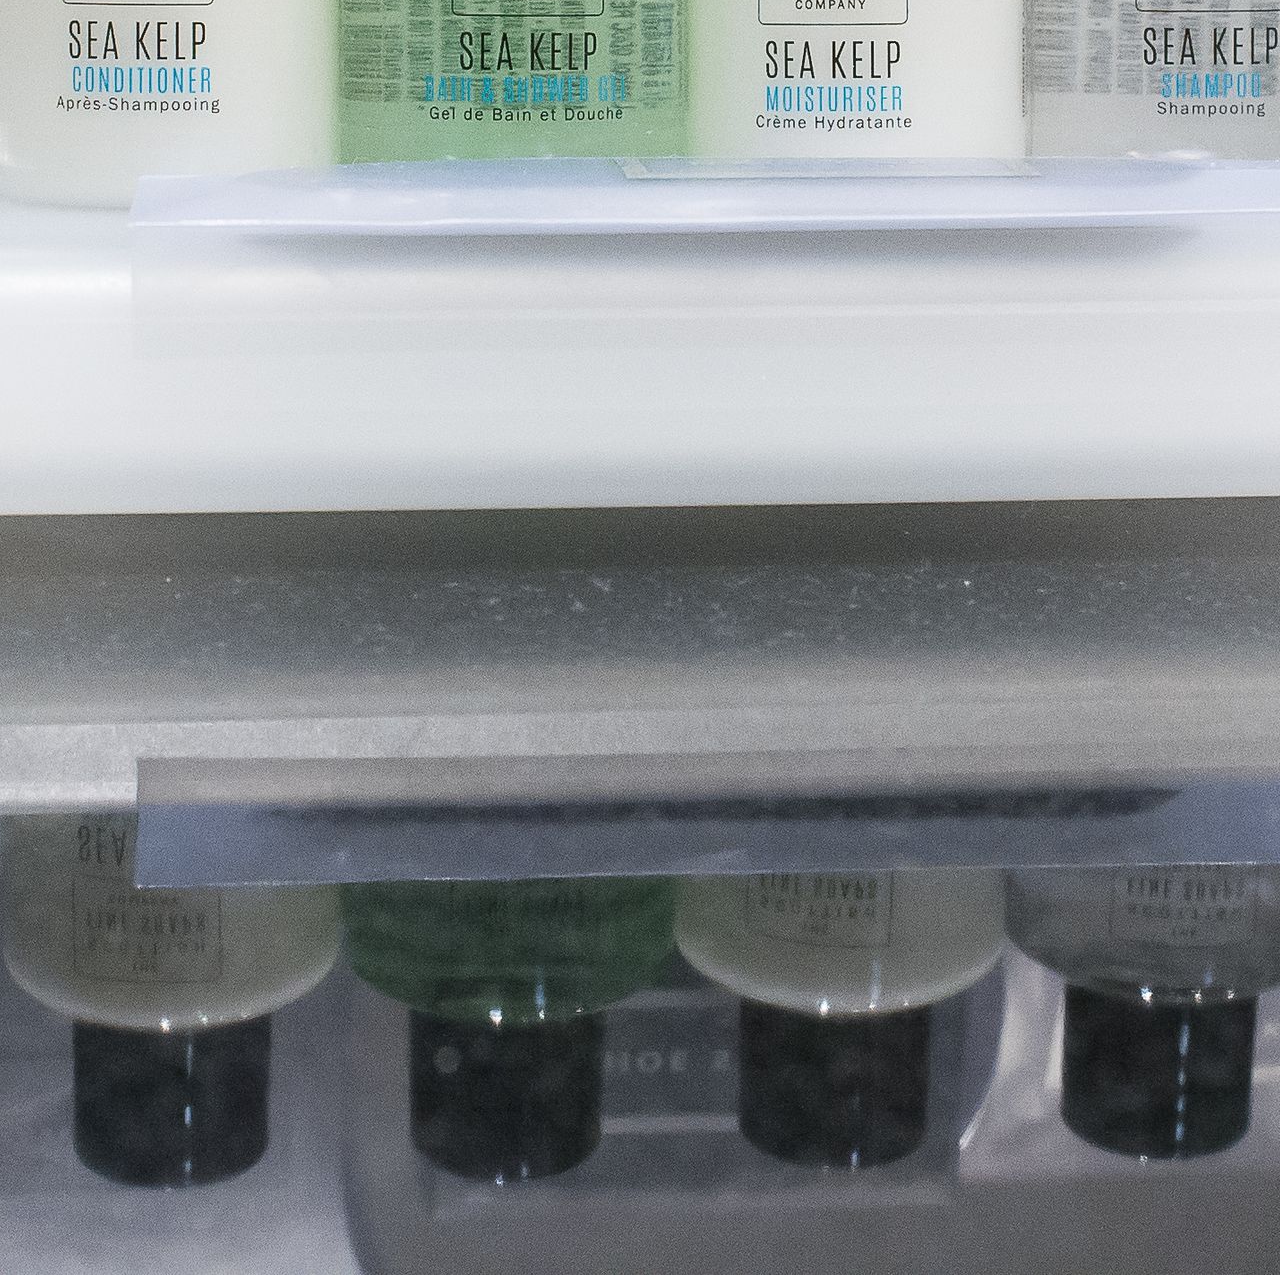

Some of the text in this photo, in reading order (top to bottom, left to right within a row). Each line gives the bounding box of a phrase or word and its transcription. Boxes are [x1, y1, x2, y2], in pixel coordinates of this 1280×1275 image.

[795, 0, 866, 11] COMPANY
[69, 20, 207, 61] SEA KELP
[459, 31, 598, 71] SEA KELP
[1143, 27, 1279, 66] SEA KELP
[765, 40, 901, 79] SEA KELP
[72, 66, 211, 94] CONDITIONER
[425, 74, 472, 102] BATH
[481, 75, 494, 104] &
[504, 75, 589, 103] SHOWER
[1161, 73, 1262, 99] SHAMPOO
[56, 95, 220, 114] Après-Shampooing
[765, 85, 903, 112] MOISTURISER
[1157, 102, 1266, 118] Shampooing
[429, 106, 623, 121] Gel de Bain et Douche
[755, 114, 912, 133] Crème Hydratante
